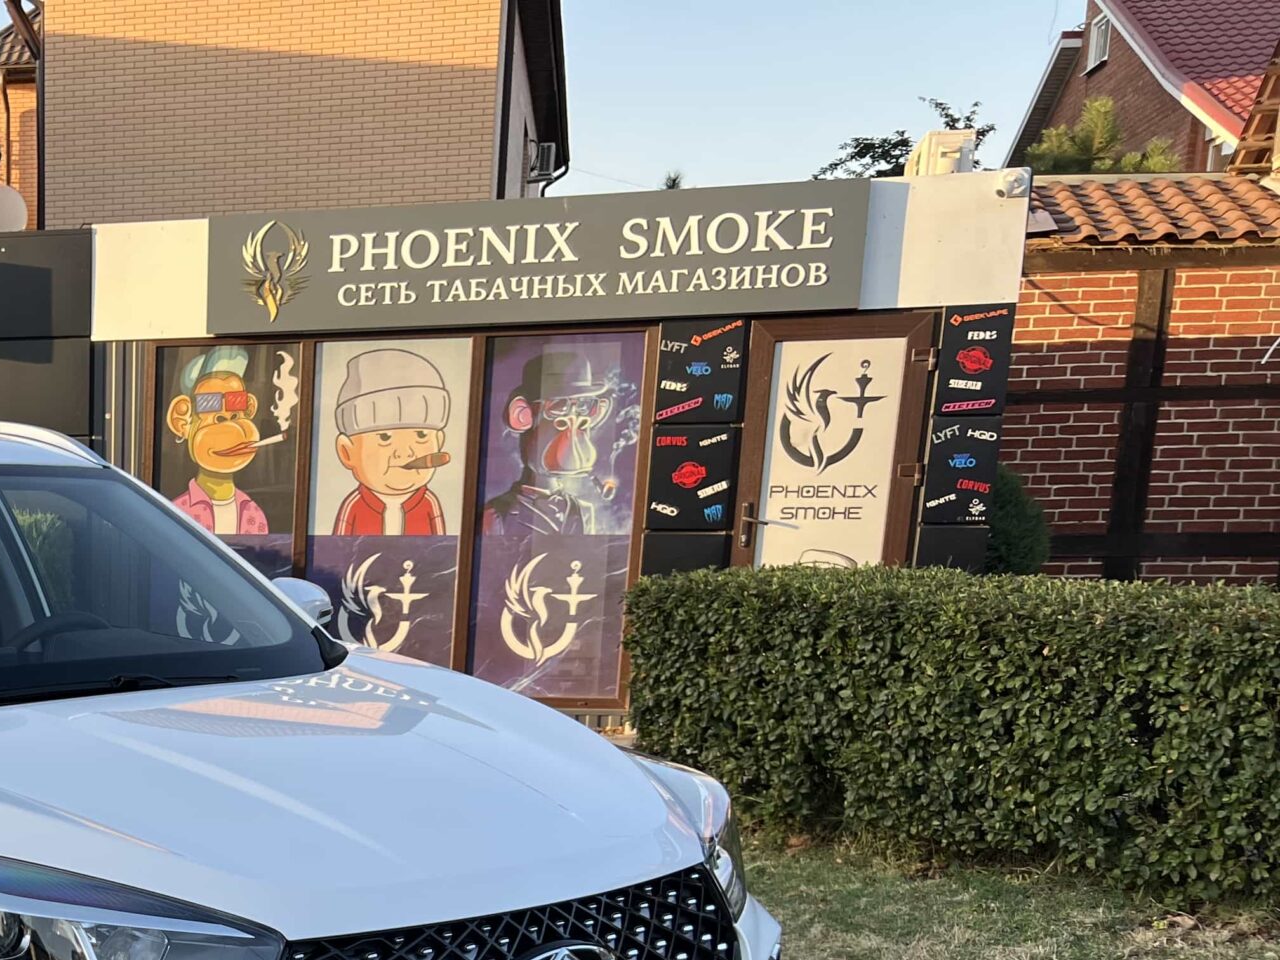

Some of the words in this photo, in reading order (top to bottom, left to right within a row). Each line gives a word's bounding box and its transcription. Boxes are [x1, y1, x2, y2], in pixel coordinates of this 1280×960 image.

[328, 222, 579, 273] PHOENIX
[620, 207, 834, 259] SMOKE
[337, 282, 417, 307] СЕТЬ
[426, 273, 607, 303] ТАБАЧНЫХ
[616, 262, 828, 295] МАГАЗИНОВ
[660, 340, 688, 354] LYFT
[686, 366, 712, 376] VELO
[699, 433, 728, 447] IGNITE
[932, 424, 961, 444] LYFT
[966, 428, 998, 441] HQD
[656, 436, 688, 447] CORVUS
[948, 457, 977, 468] VELO
[769, 484, 878, 499] PHOENIX
[956, 478, 991, 494] CORVUS
[925, 493, 957, 508] IGNITE
[780, 506, 863, 520] SMOKE
